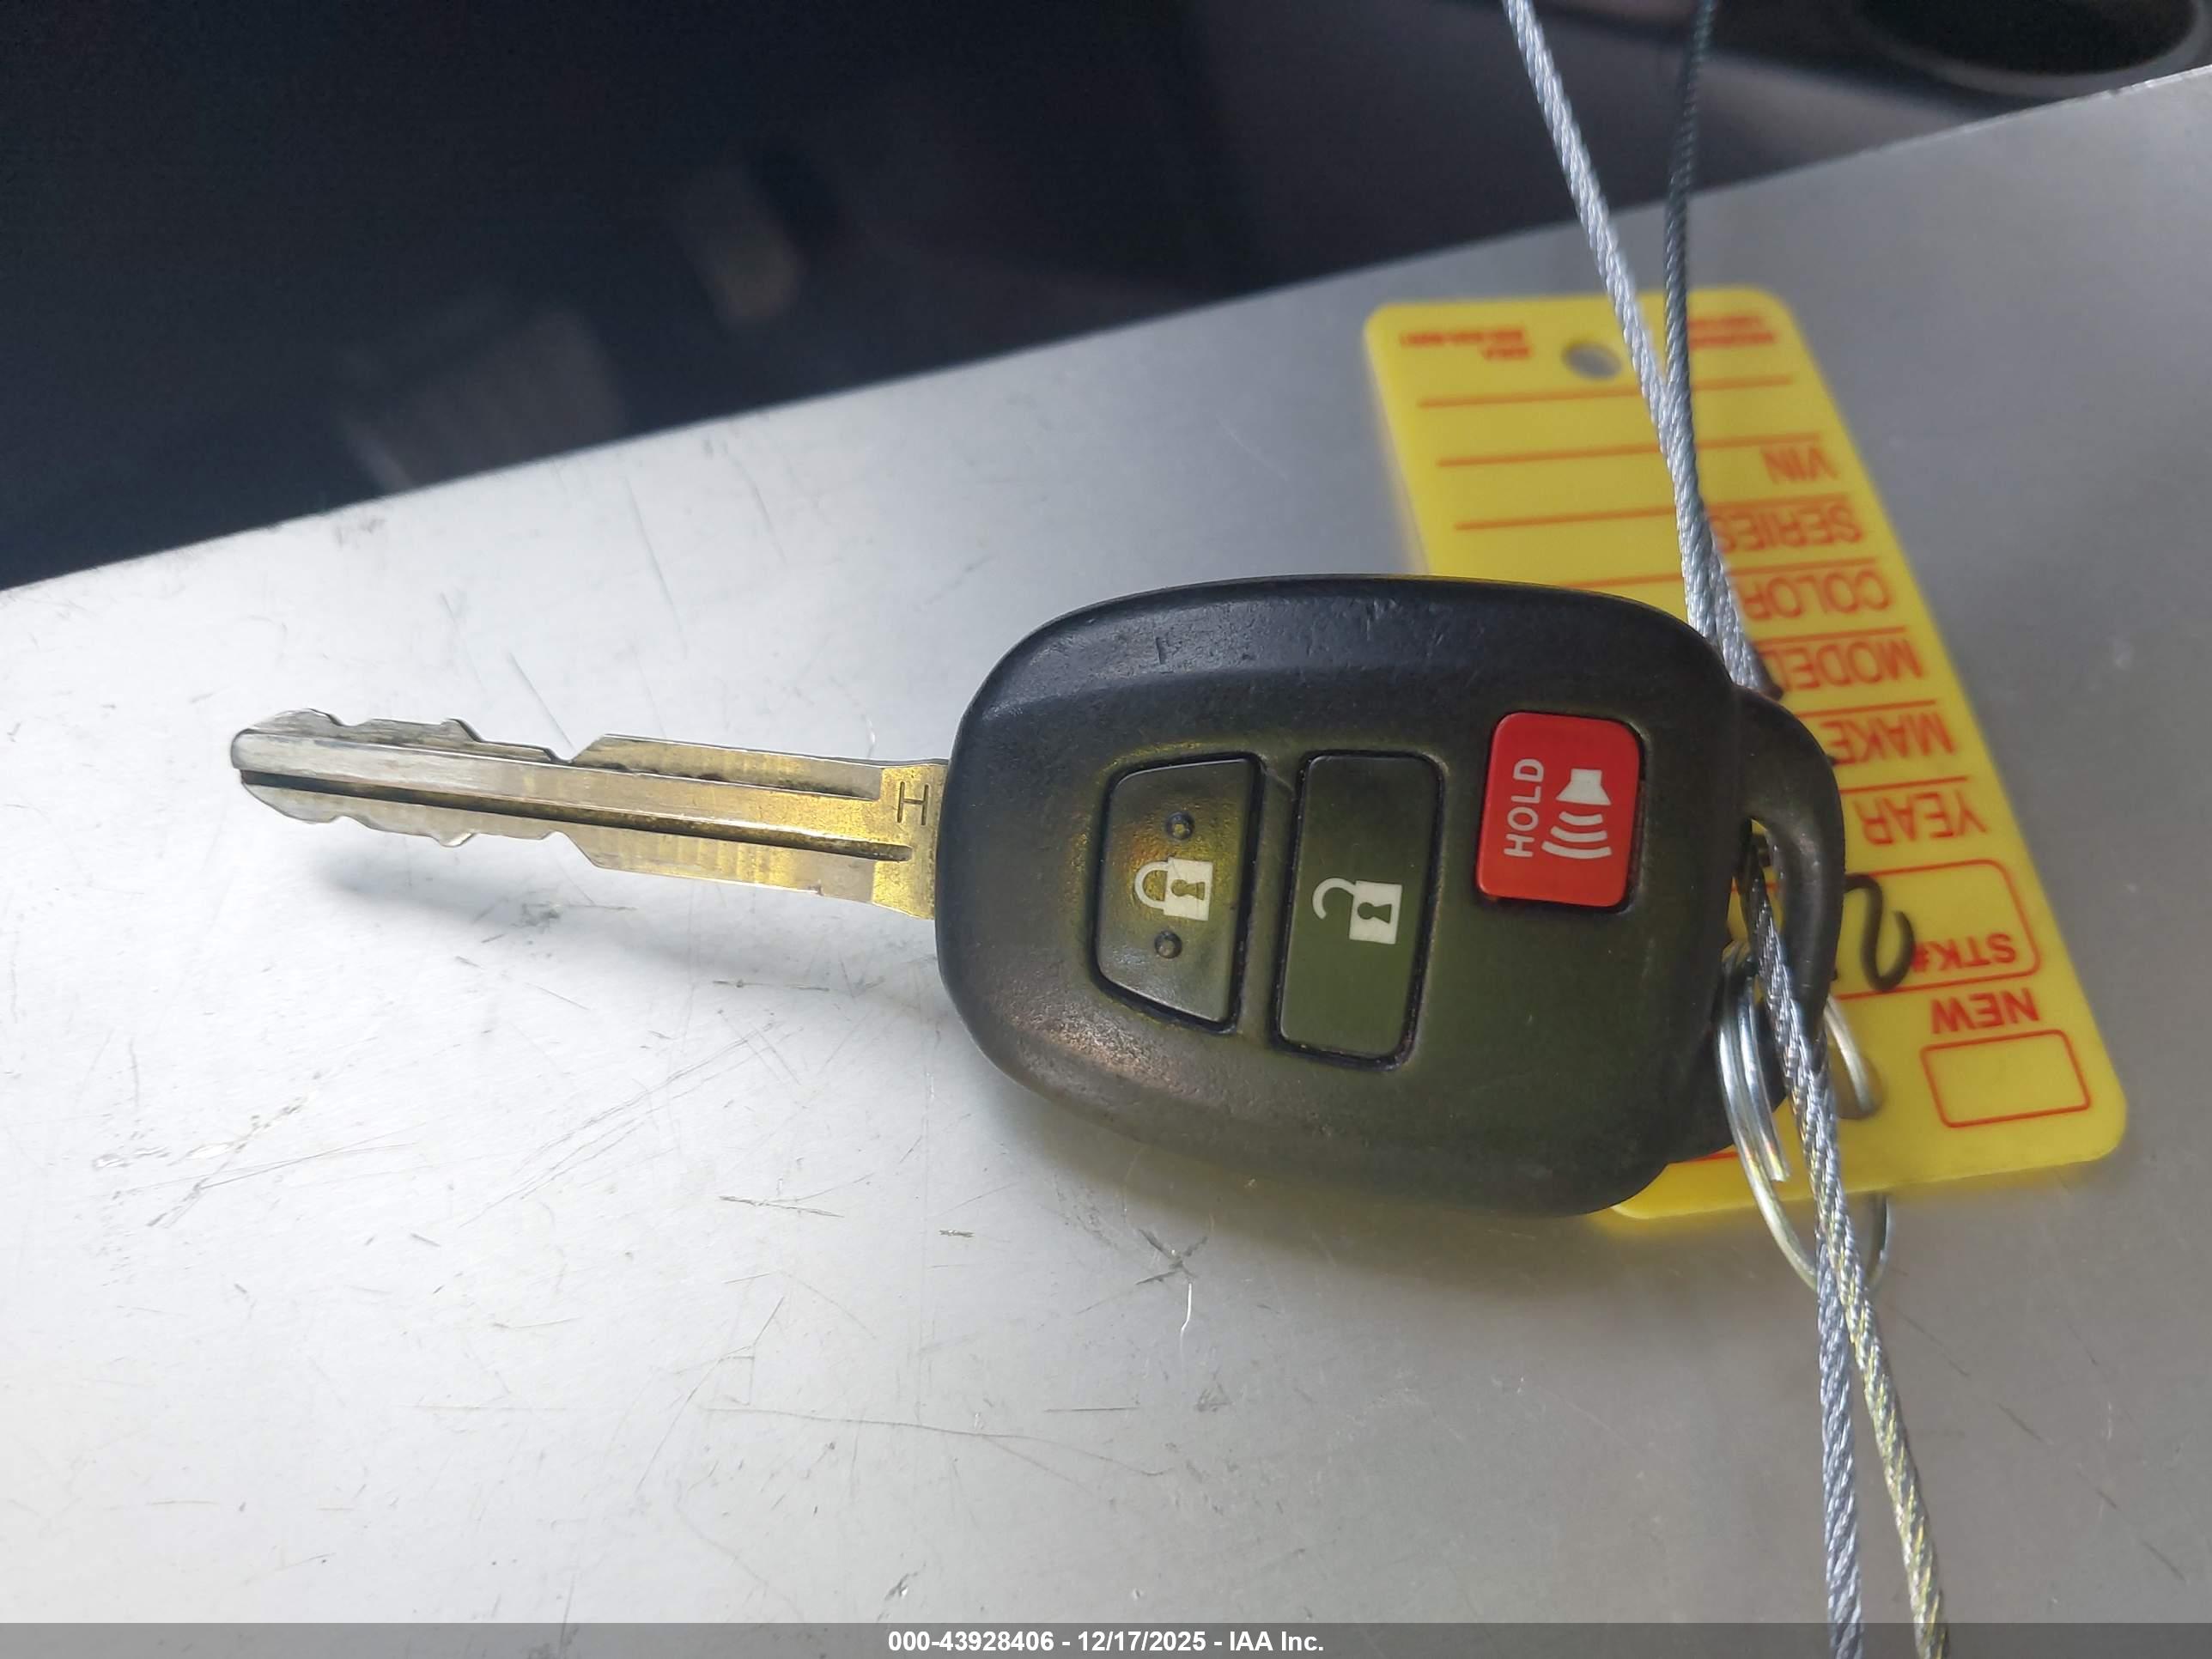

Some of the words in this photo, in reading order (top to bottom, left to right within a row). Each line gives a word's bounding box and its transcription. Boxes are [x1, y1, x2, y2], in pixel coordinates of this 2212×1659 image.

[1760, 447, 1837, 483] VIN
[1709, 504, 1862, 554] SERIES
[1759, 638, 1923, 690] MODEL
[1819, 712, 1955, 766] MAKE
[896, 781, 929, 826] H
[1504, 758, 1544, 857] HOLD
[1854, 788, 1989, 846] YEAR
[1930, 988, 2039, 1034] NEW
